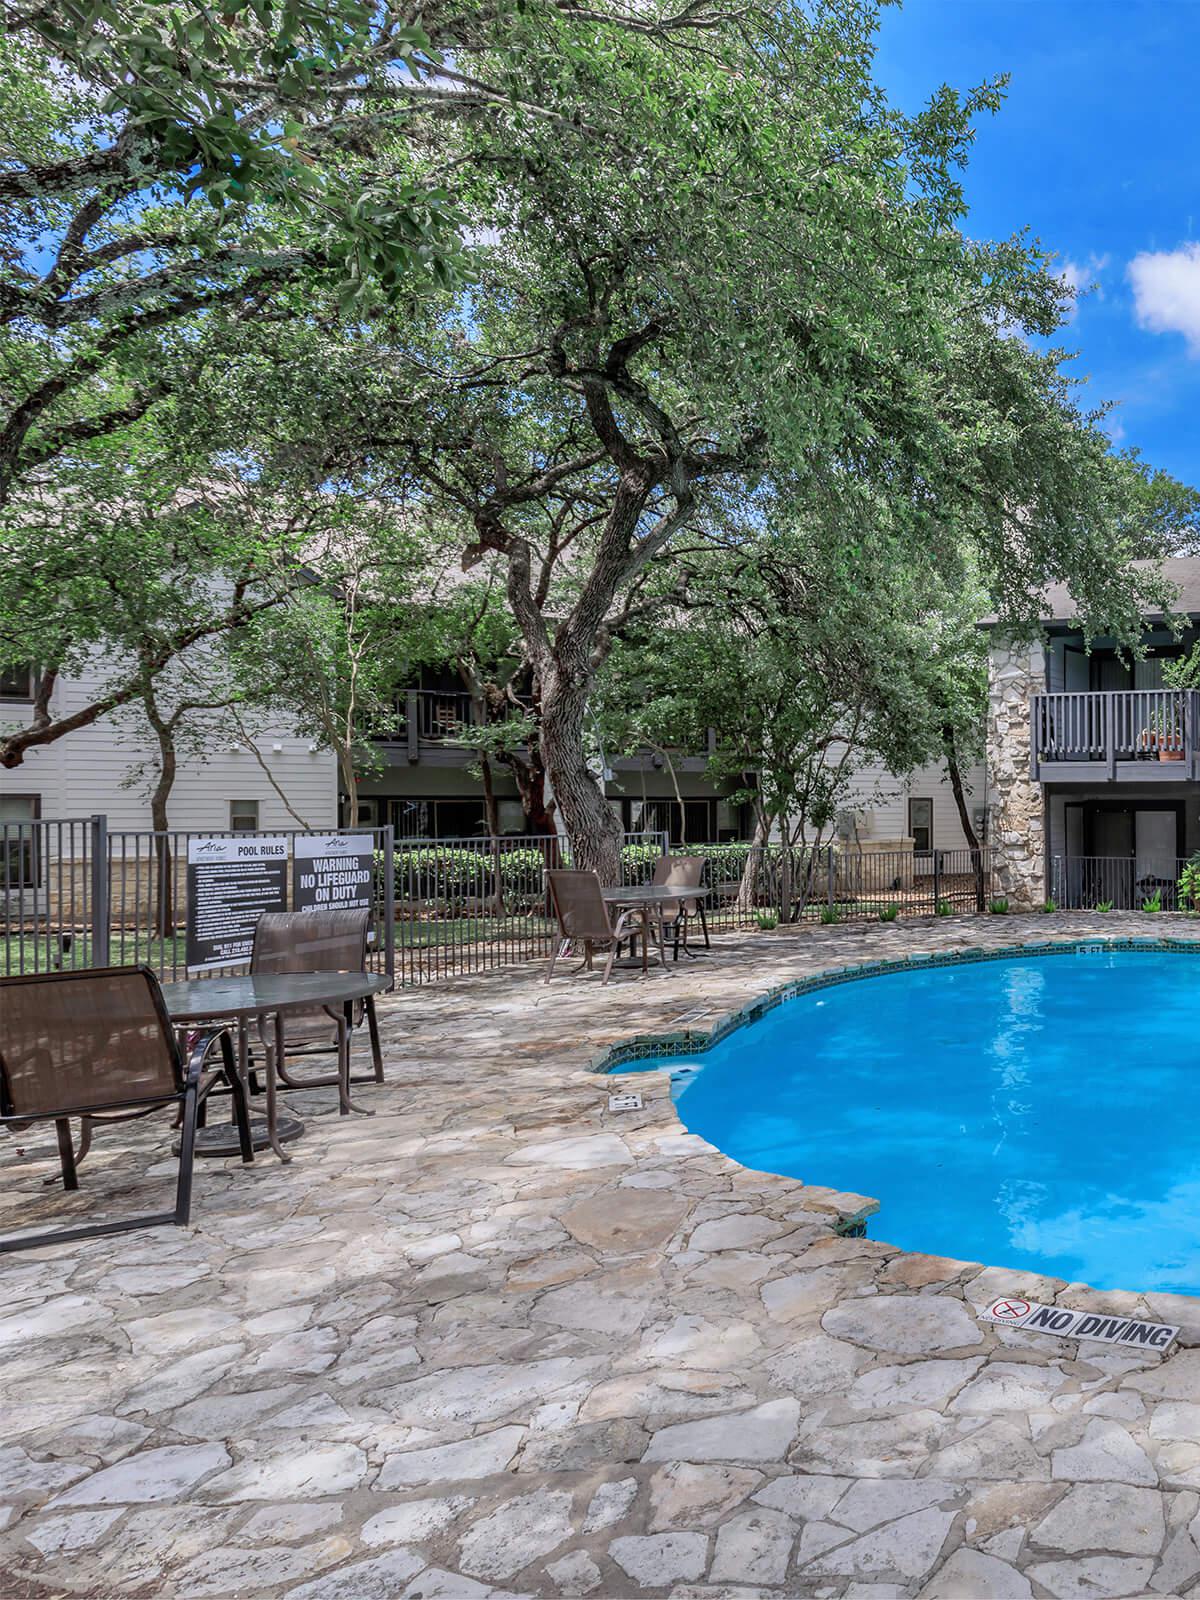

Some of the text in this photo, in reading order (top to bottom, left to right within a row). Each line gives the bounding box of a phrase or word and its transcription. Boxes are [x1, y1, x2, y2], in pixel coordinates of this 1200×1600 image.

[238, 845, 285, 857] POOL RULES
[312, 857, 360, 873] WARNING
[300, 870, 371, 889] NO LIFEGUARD
[315, 886, 358, 902] ON DUTY
[329, 900, 349, 910] SHOULD
[349, 899, 359, 907] NOT
[359, 898, 369, 906] USE
[1029, 1308, 1173, 1348] NO DIVING
